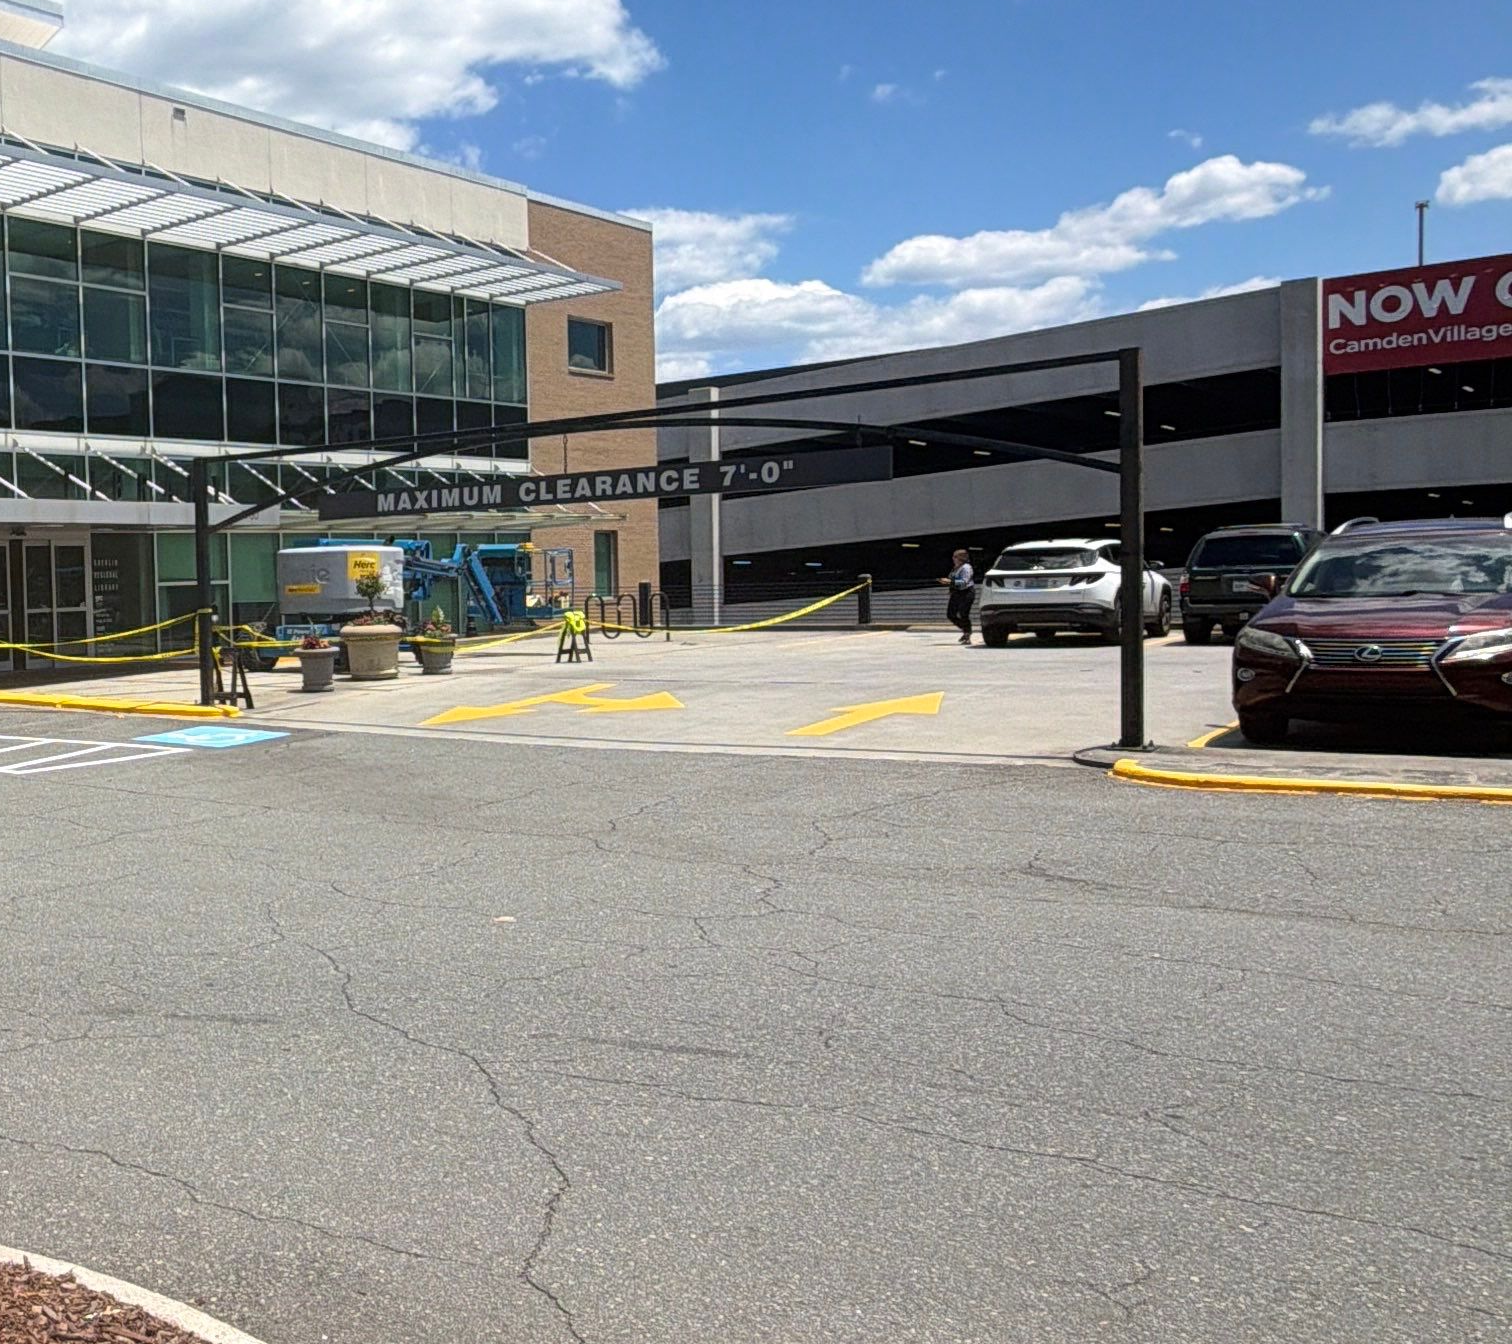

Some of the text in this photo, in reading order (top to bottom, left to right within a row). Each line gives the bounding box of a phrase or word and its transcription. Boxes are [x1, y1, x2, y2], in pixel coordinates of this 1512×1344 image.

[1328, 275, 1476, 330] NOW
[377, 484, 502, 513] MAXIMUM
[519, 467, 700, 502] CLEARANCE
[353, 560, 376, 569] Herc
